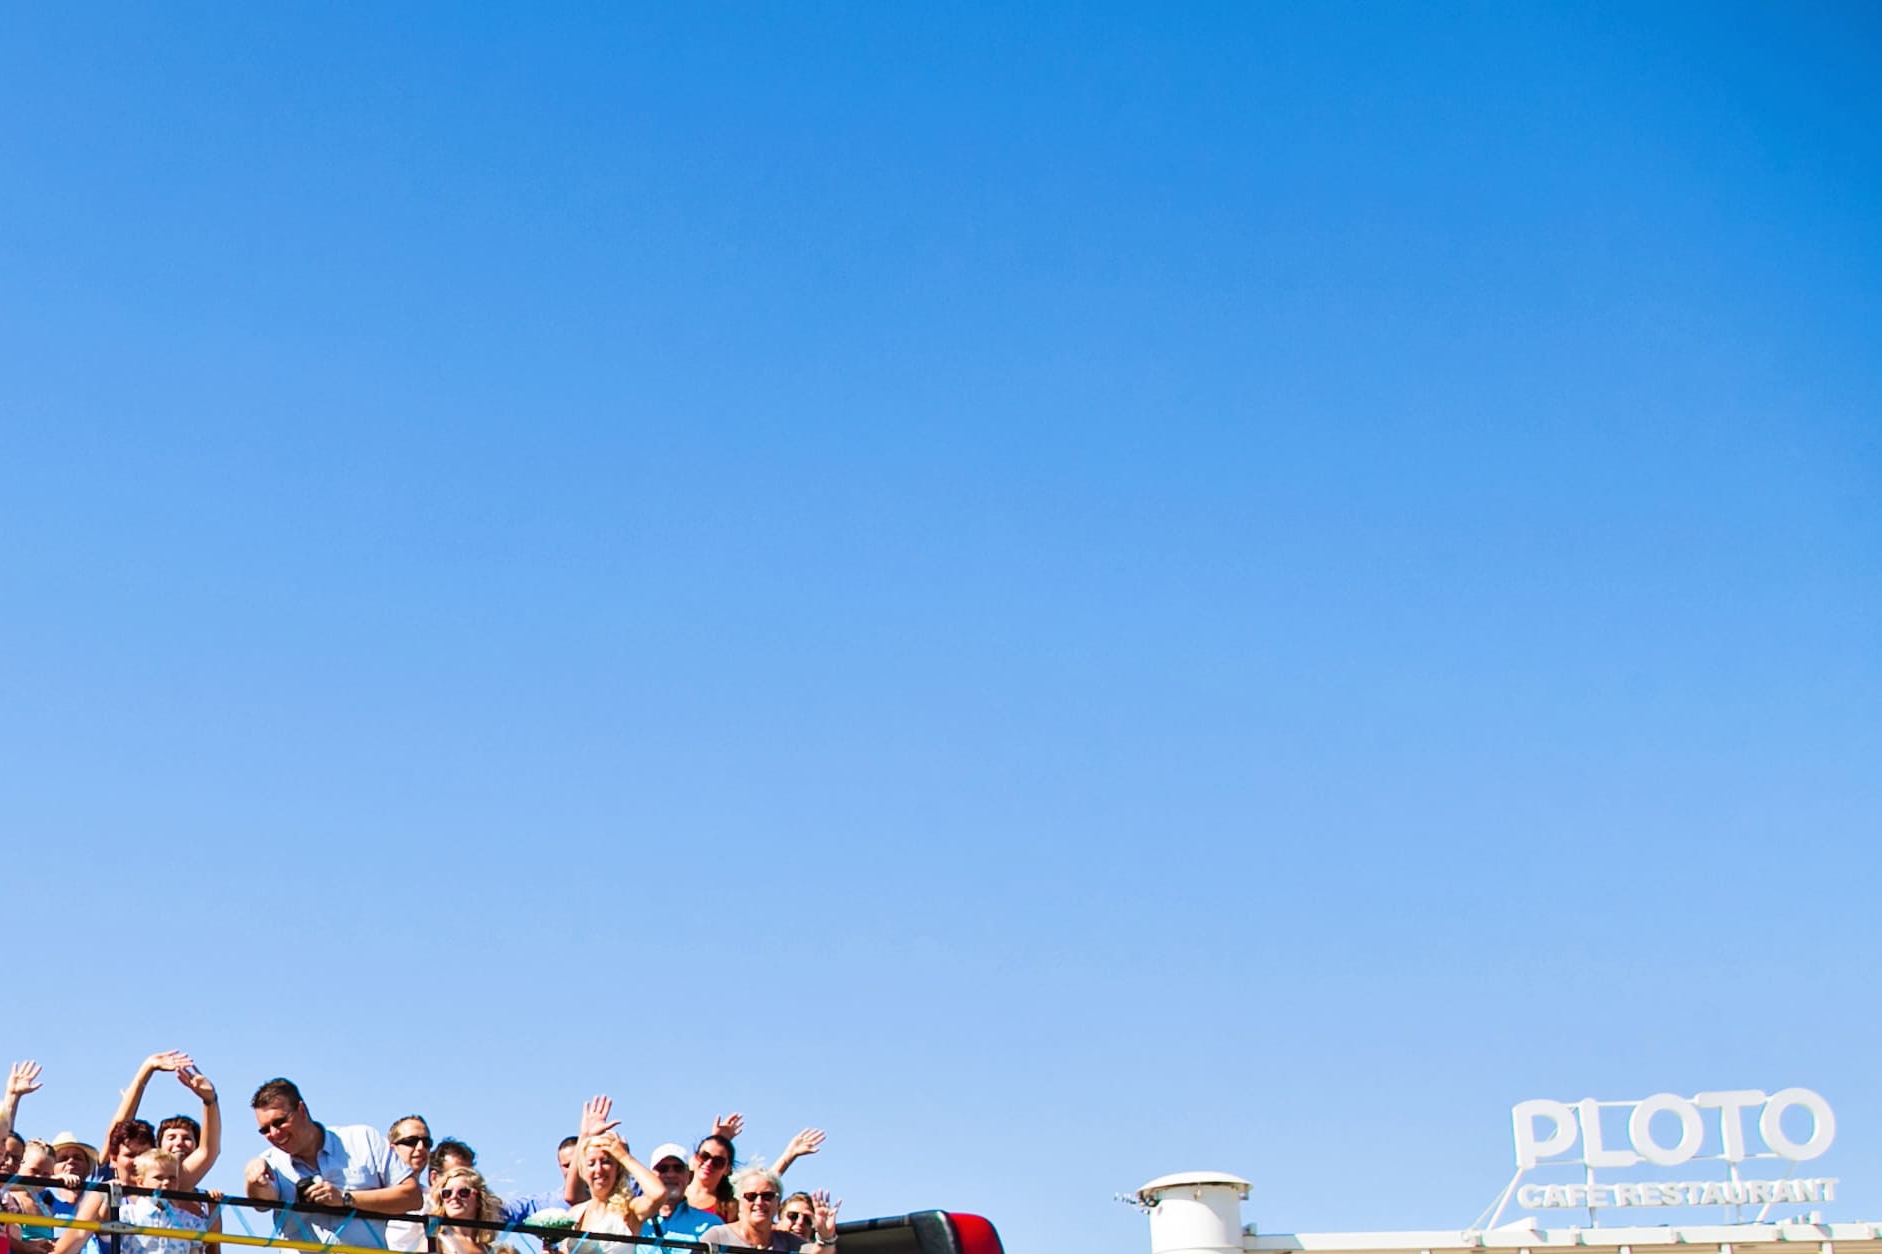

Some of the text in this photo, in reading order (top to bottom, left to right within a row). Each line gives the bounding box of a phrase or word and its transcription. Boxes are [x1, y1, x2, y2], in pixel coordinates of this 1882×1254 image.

[1511, 1087, 1836, 1169] PLOTO
[1517, 1178, 1840, 1209] CAFE RESTAURANT
